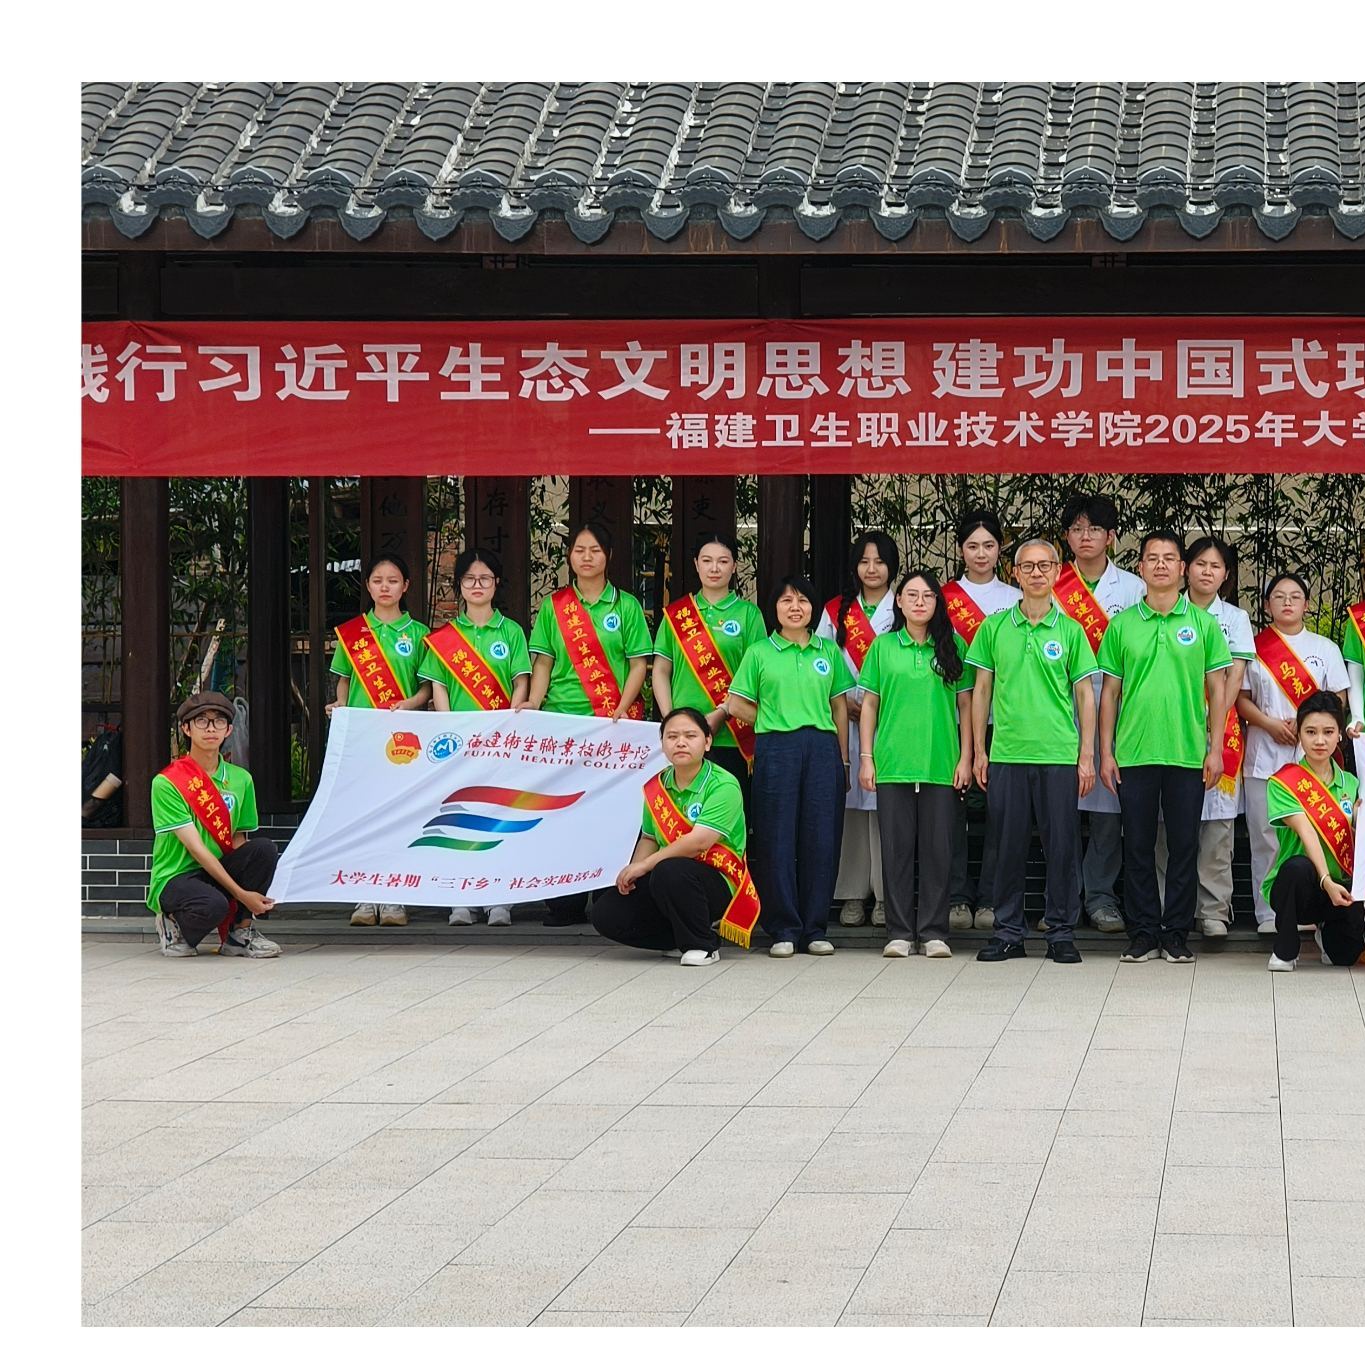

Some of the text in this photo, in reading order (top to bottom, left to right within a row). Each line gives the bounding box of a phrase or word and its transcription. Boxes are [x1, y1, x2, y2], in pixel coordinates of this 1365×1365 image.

[844, 607, 869, 652] 建卫生
[352, 637, 399, 711] 福建卫生职
[463, 751, 511, 760] FUJIAN
[520, 755, 574, 766] HEALTH
[330, 868, 421, 891] 大学生暑期
[509, 867, 603, 890] 社会实践活动
